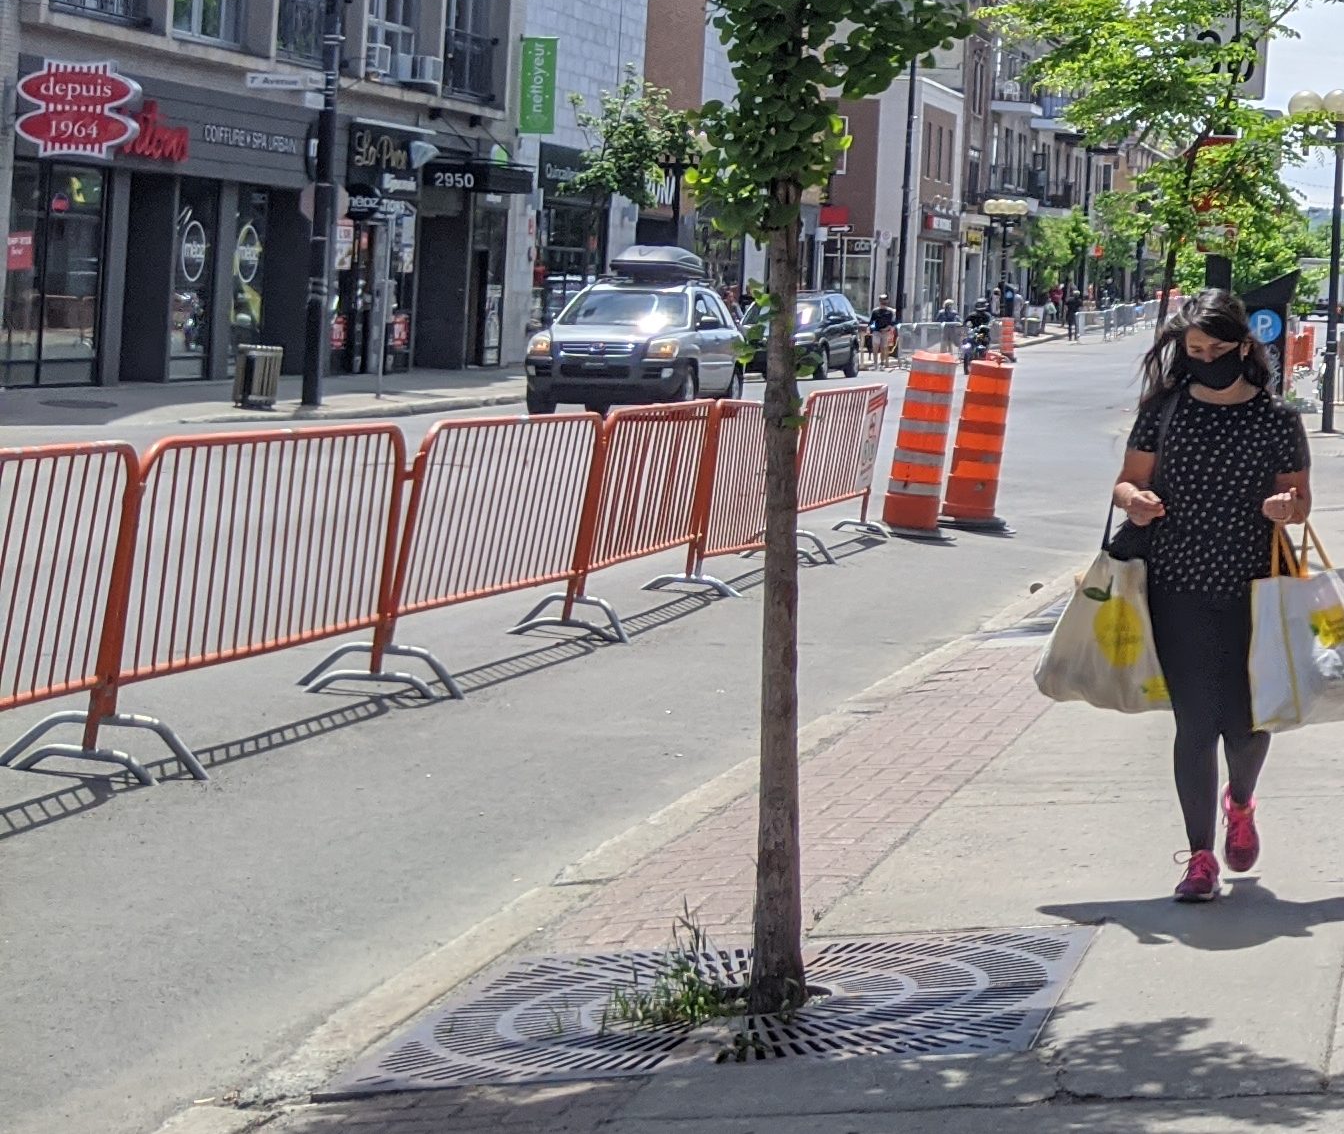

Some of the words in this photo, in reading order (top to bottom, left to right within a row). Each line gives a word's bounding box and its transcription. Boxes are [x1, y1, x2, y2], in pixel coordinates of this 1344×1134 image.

[531, 42, 545, 113] nettoyeur
[40, 77, 112, 101] depuis
[50, 120, 99, 138] 1964
[434, 172, 475, 188] 2950
